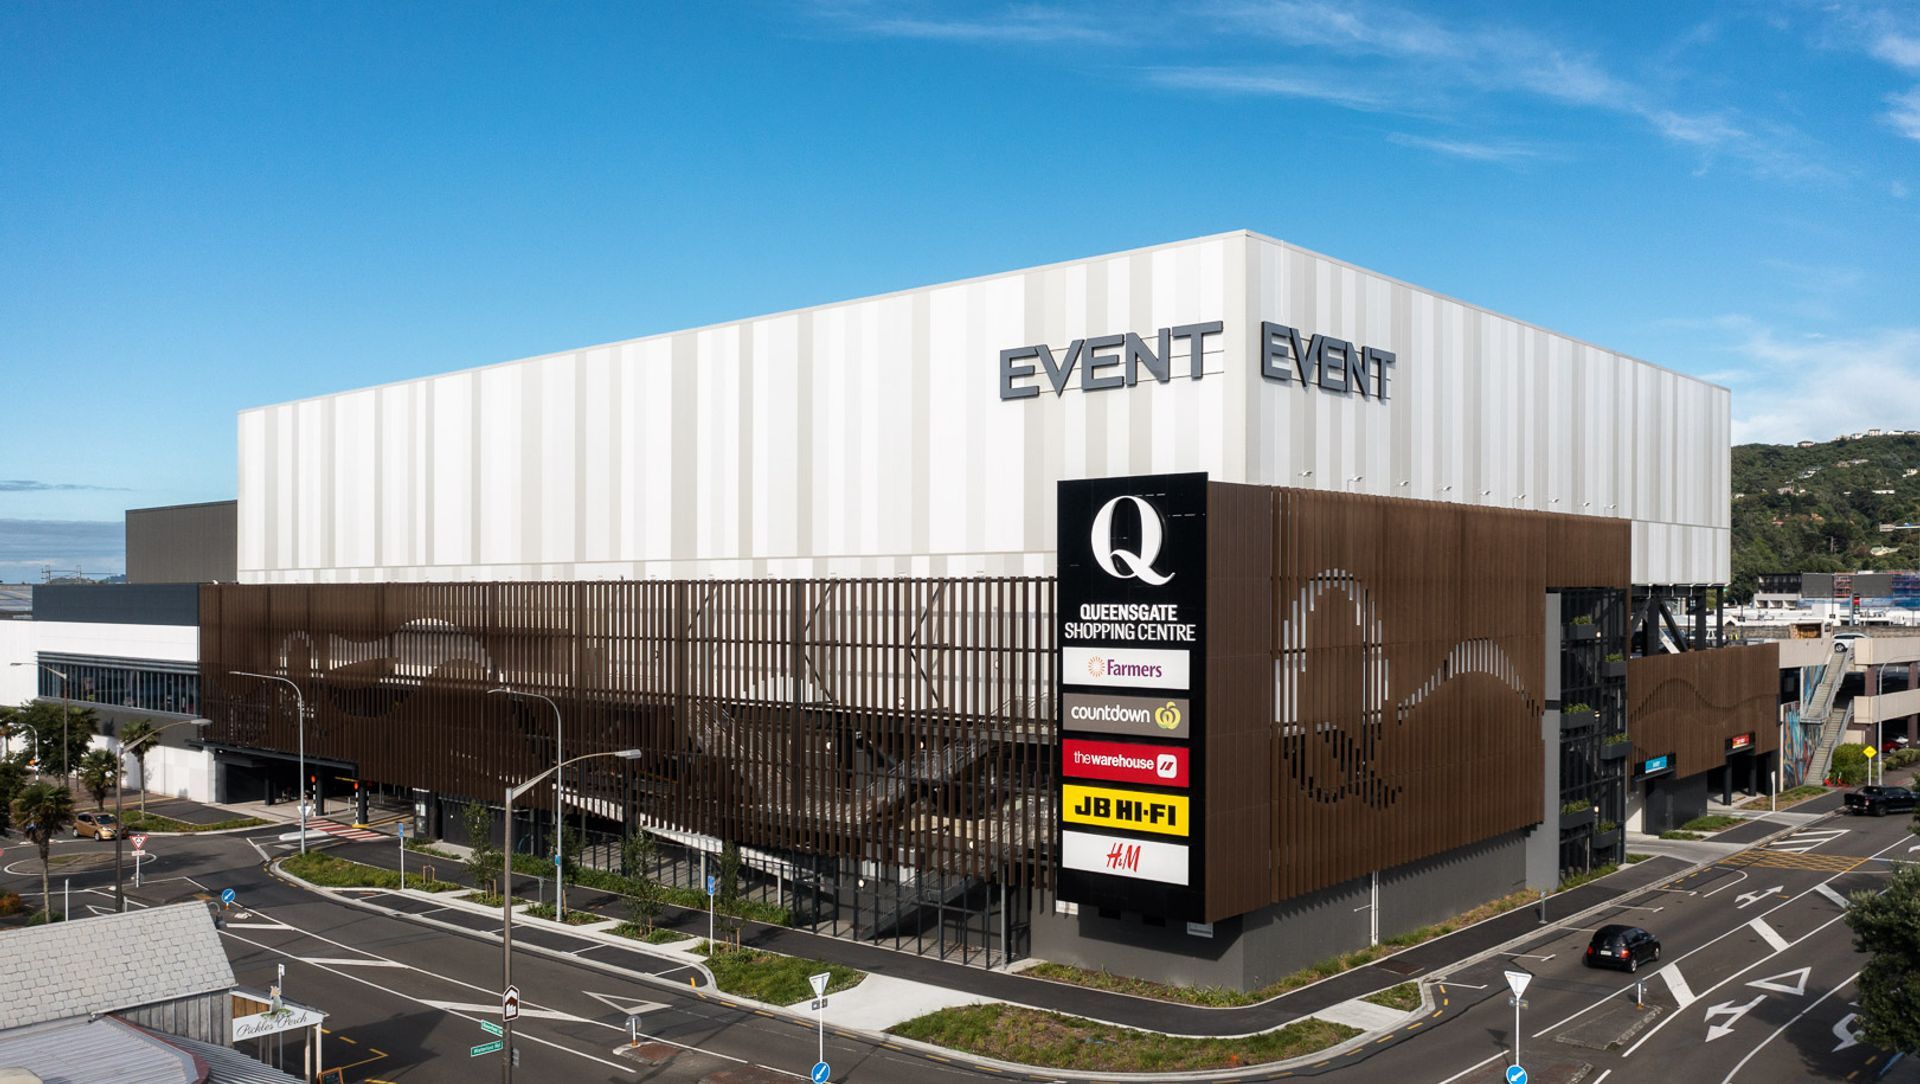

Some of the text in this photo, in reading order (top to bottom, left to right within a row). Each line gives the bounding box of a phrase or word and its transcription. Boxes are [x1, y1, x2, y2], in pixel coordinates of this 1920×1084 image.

[1000, 320, 1223, 401] EVENT
[1261, 321, 1396, 402] EVENT
[1091, 495, 1176, 586] Q
[1080, 603, 1178, 621] QUEENSGATE
[1064, 622, 1197, 642] SHOPPING CENTRE
[1107, 659, 1163, 678] Farmers
[1071, 704, 1151, 723] countdown
[1074, 796, 1111, 819] JB
[1106, 842, 1141, 873] H&M
